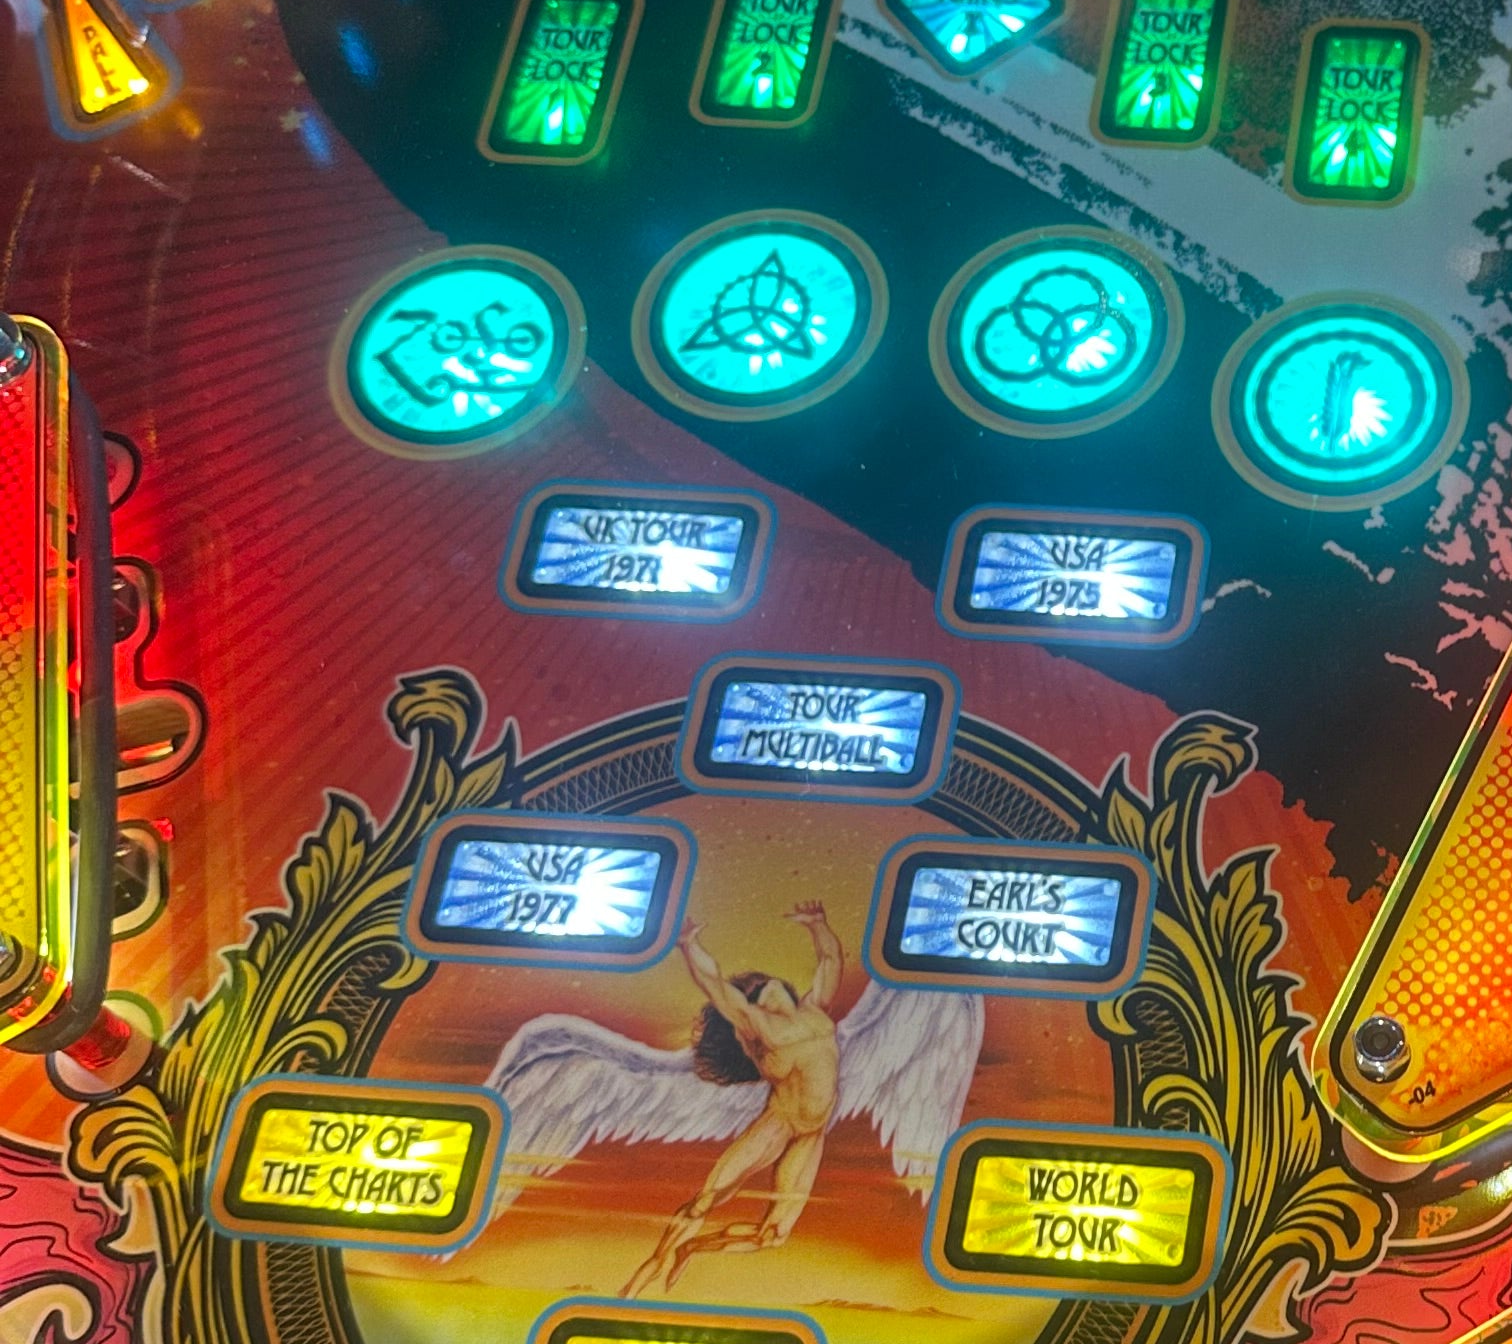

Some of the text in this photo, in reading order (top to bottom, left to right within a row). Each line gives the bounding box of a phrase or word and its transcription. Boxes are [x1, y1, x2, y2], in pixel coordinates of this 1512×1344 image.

[740, 22, 803, 46] LOCK
[1140, 10, 1202, 34] TOUR
[540, 28, 606, 51] TOUR
[1135, 42, 1200, 65] LOCK
[530, 59, 595, 82] LOCK
[1330, 66, 1394, 91] TOUR
[1326, 99, 1390, 122] LOCK
[583, 515, 708, 547] UK TOUR
[603, 554, 662, 584] 1971
[1050, 538, 1107, 571] USA
[1037, 579, 1101, 609] 1975
[789, 690, 863, 722] TOUR
[742, 728, 884, 765] MULTIBALL
[526, 848, 586, 883] USA
[509, 891, 577, 924] 1977
[967, 877, 1065, 912] EARL'S
[957, 918, 1065, 954] COURT
[1408, 1079, 1437, 1105] -04
[308, 1118, 424, 1160] TOP OF
[262, 1160, 443, 1206] THE CHARTS
[1028, 1166, 1139, 1207] WORLD
[1032, 1212, 1126, 1252] TOUR
